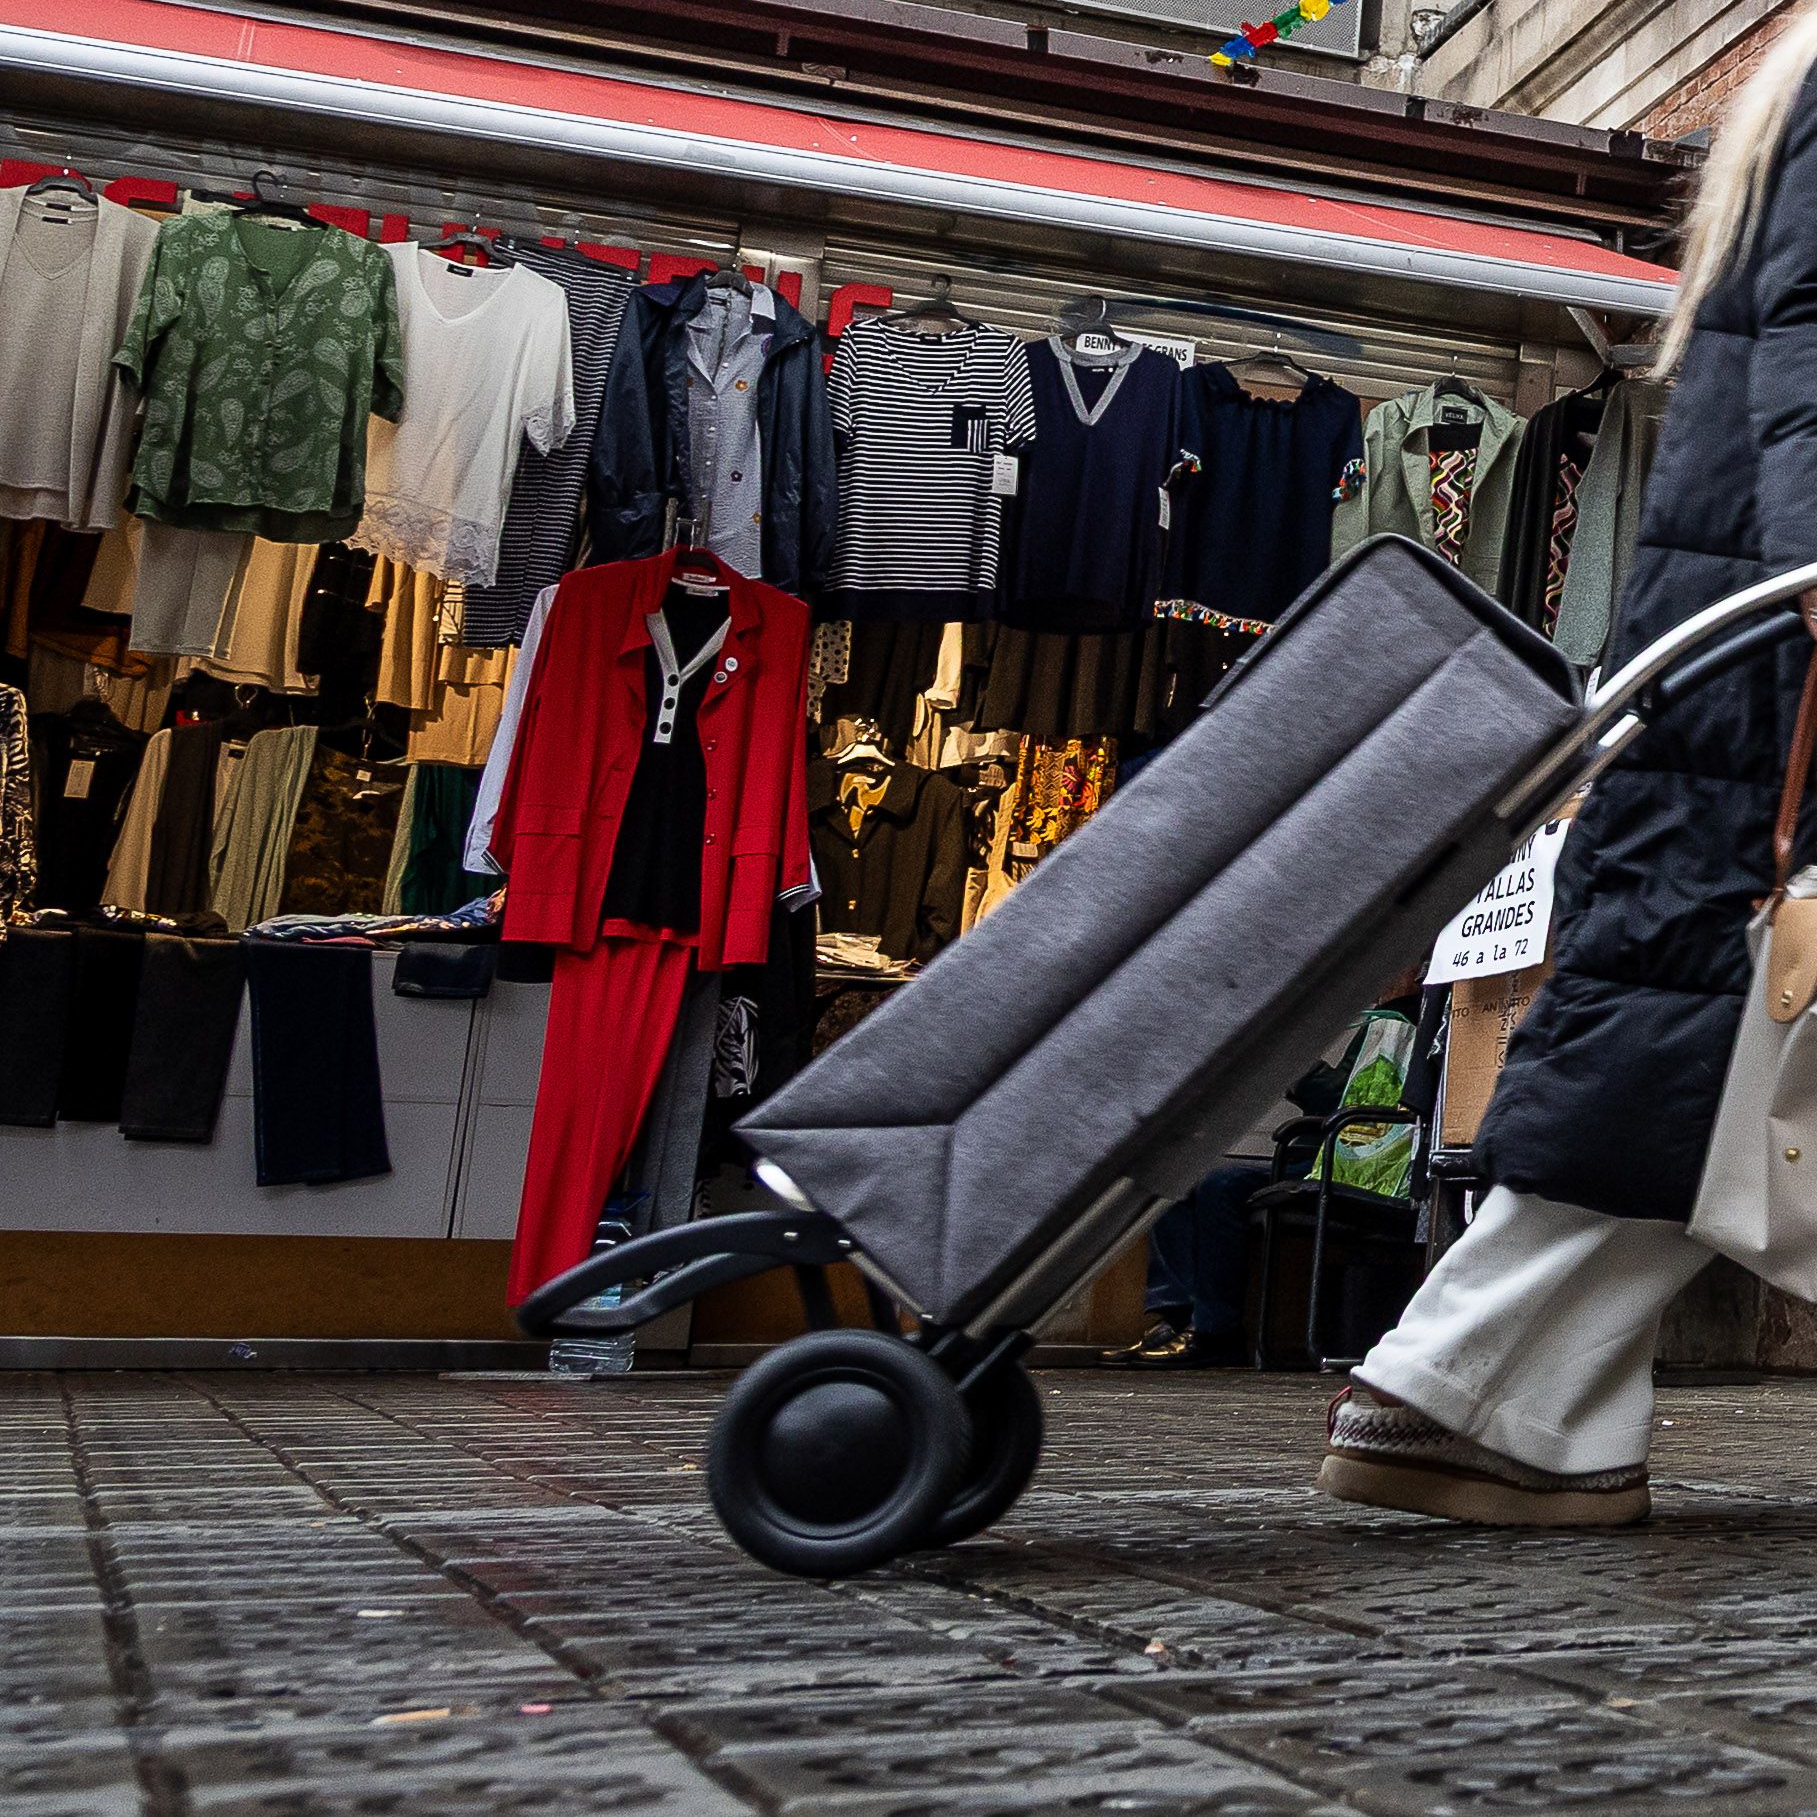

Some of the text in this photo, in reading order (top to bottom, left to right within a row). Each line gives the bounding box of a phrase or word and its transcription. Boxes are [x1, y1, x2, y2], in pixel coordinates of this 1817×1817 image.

[1461, 900, 1536, 938] GRANDES
[1453, 938, 1529, 968] 46 a la 72
